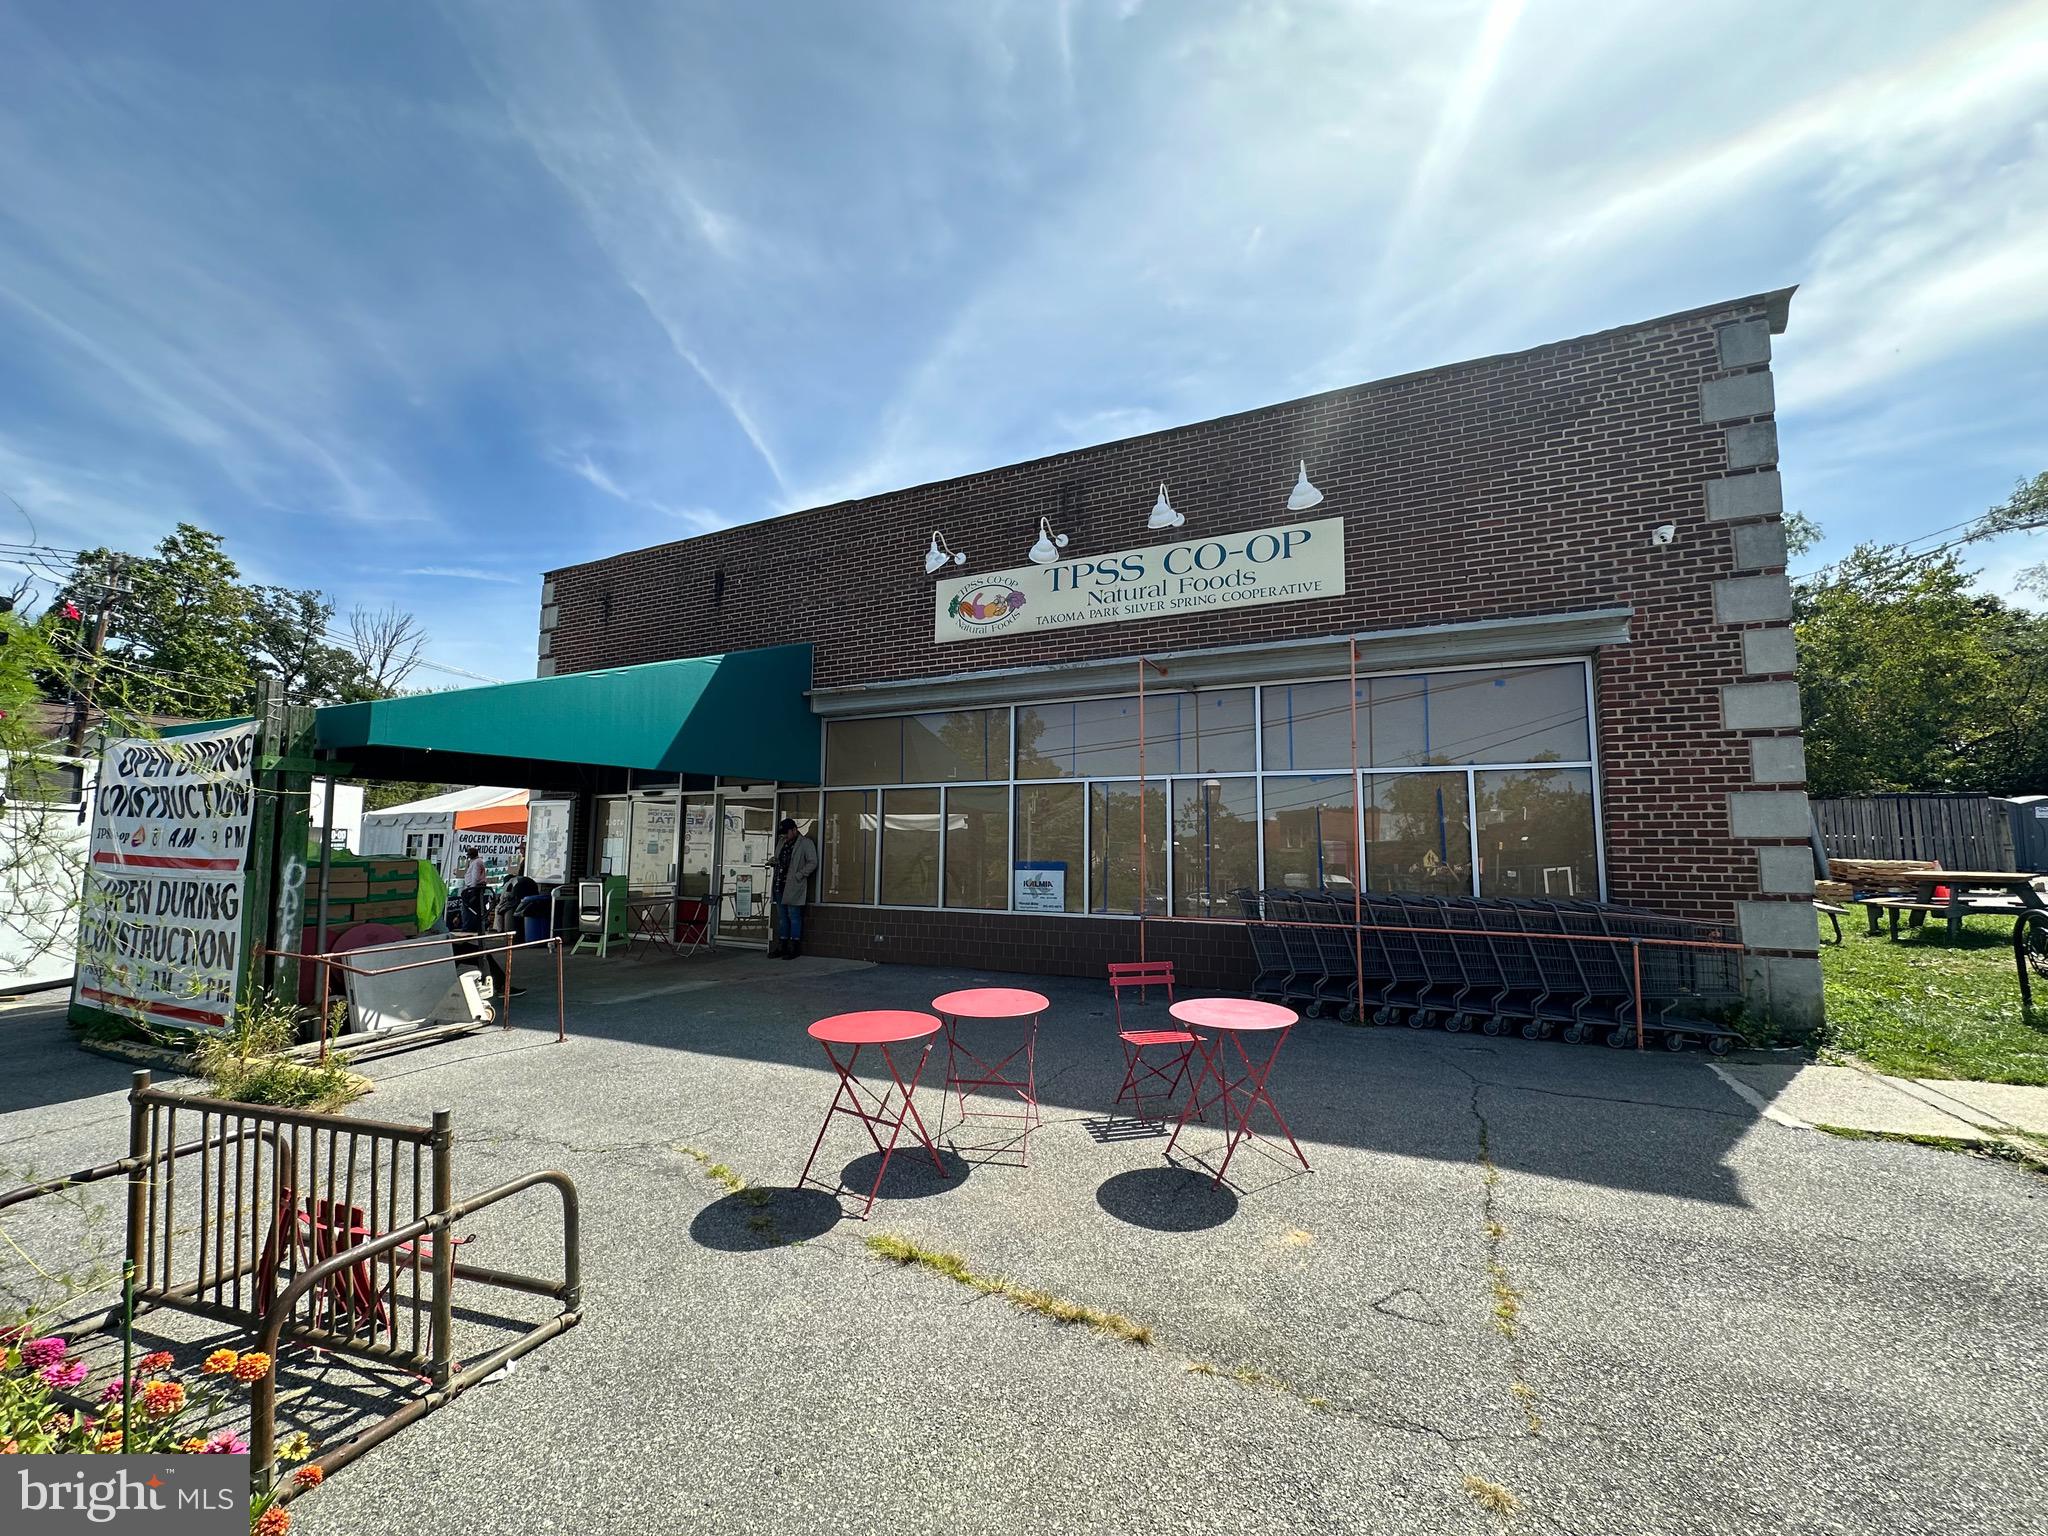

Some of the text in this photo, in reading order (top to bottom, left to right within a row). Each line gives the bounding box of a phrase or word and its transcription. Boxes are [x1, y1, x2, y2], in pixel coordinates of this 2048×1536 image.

[1043, 529, 1312, 592] TPSS CO-OP
[958, 575, 1019, 596] TPSS CO-OP
[1035, 580, 1323, 625] TAKOMA PARK SILVER SPRING COOPERATIVE
[1087, 568, 1257, 606] Natural Foods
[955, 612, 1020, 634] Natural Foods
[118, 746, 174, 778] OPEN
[100, 779, 251, 820] CONSTRUCTION
[168, 827, 197, 848] AM
[212, 830, 218, 843] 9
[224, 826, 246, 849] PM
[103, 880, 239, 921] OPEN DURING
